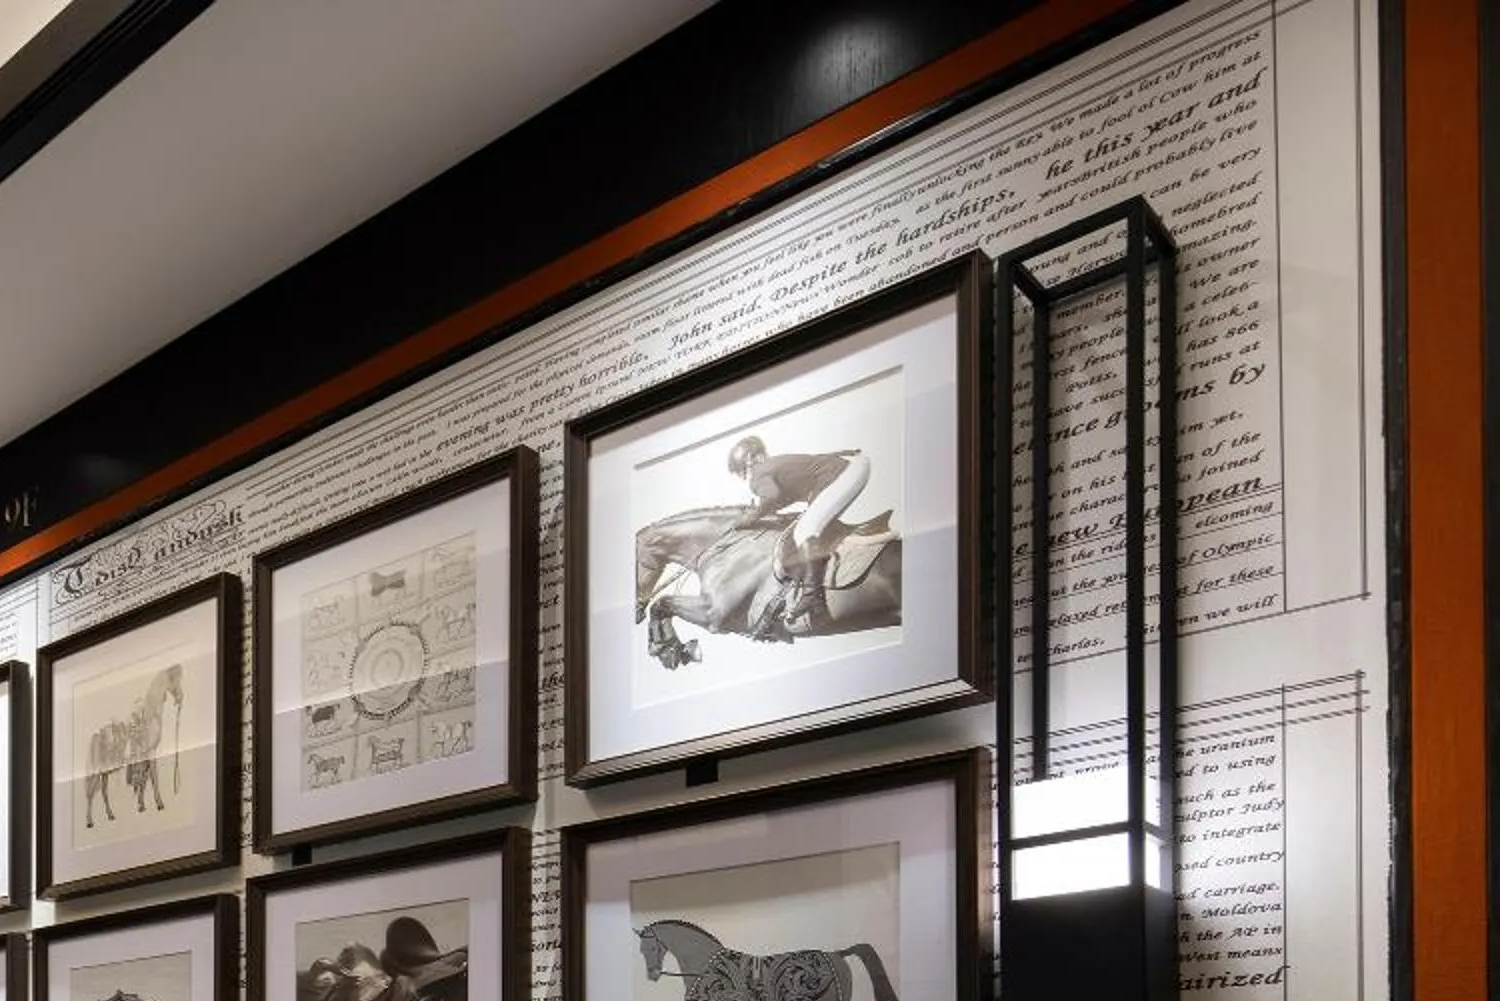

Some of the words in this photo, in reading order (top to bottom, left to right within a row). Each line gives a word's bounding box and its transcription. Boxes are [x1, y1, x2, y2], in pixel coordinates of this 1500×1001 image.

[1084, 132, 1133, 163] this
[1141, 102, 1200, 142] year
[1207, 67, 1268, 109] and
[1229, 364, 1265, 385] by
[1231, 433, 1260, 448] the
